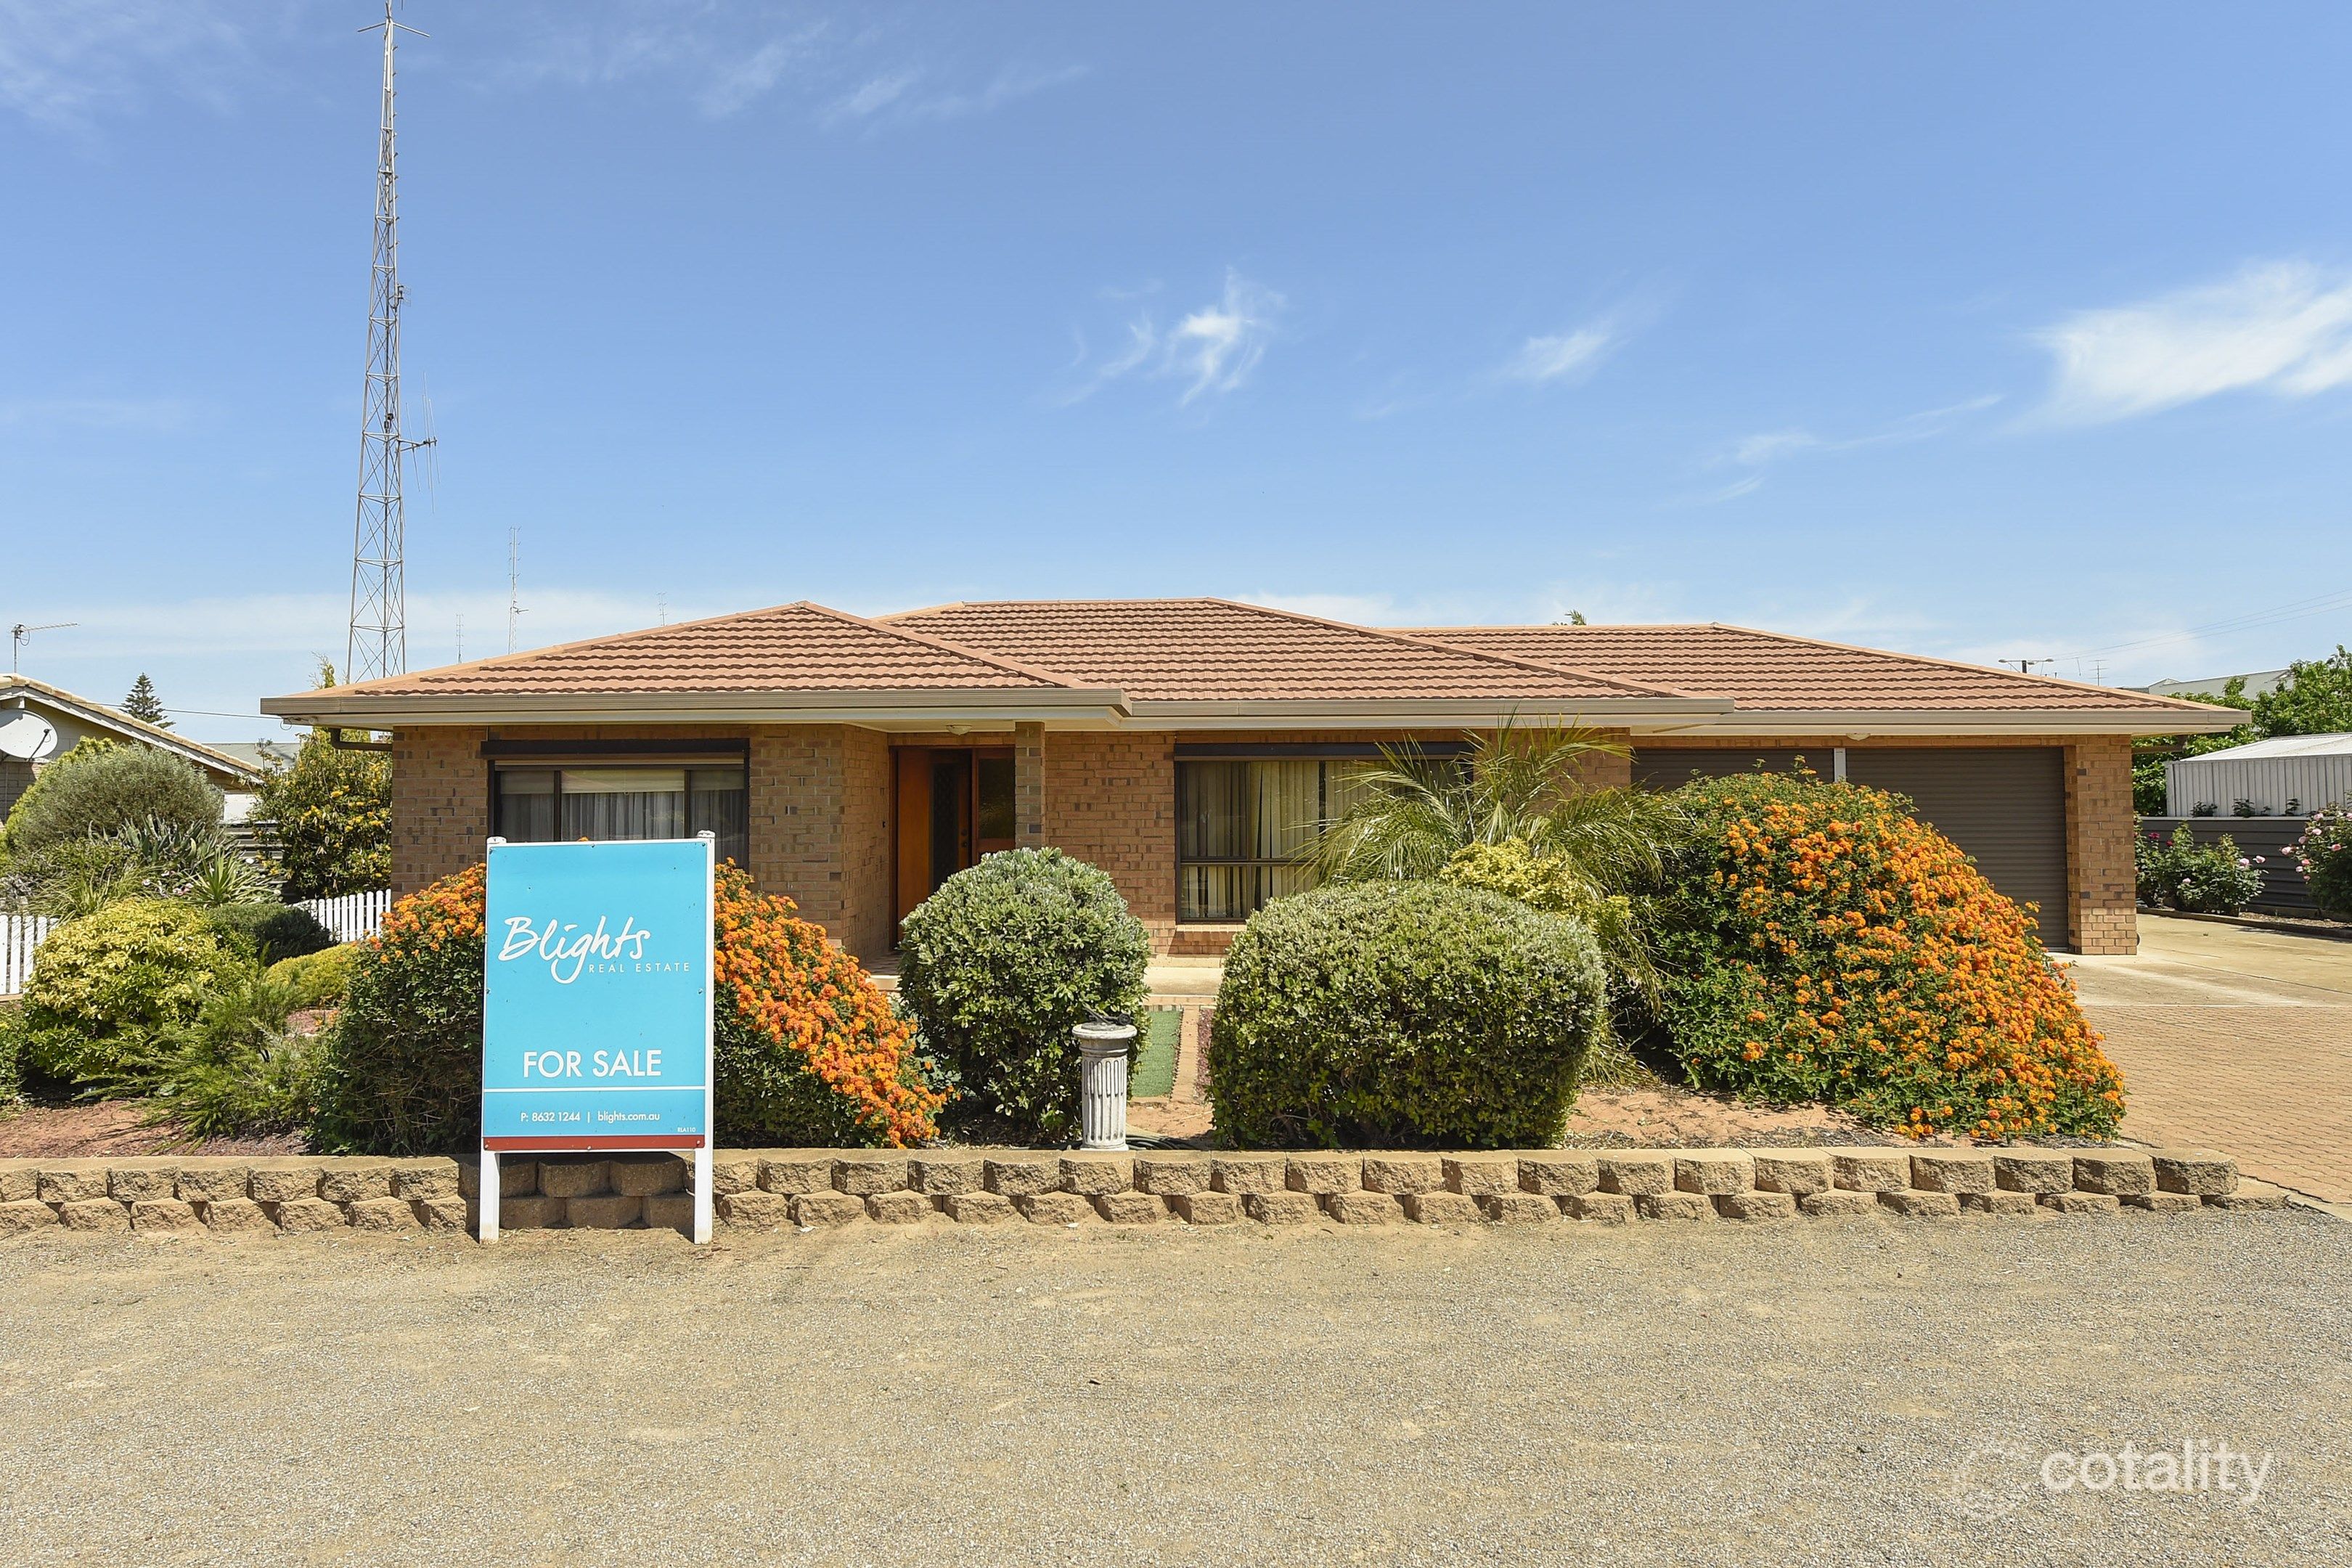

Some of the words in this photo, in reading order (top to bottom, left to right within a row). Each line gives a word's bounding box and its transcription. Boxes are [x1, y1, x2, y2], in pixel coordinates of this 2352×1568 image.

[497, 915, 651, 984] Blights
[588, 963, 625, 973] REAL
[634, 962, 690, 973] ESTATE
[523, 1050, 583, 1078] FOR
[592, 1049, 662, 1077] SALE
[520, 1111, 529, 1123] P:
[531, 1111, 555, 1122] 8632
[558, 1111, 581, 1122] 1244
[597, 1110, 661, 1124] blights.com.au
